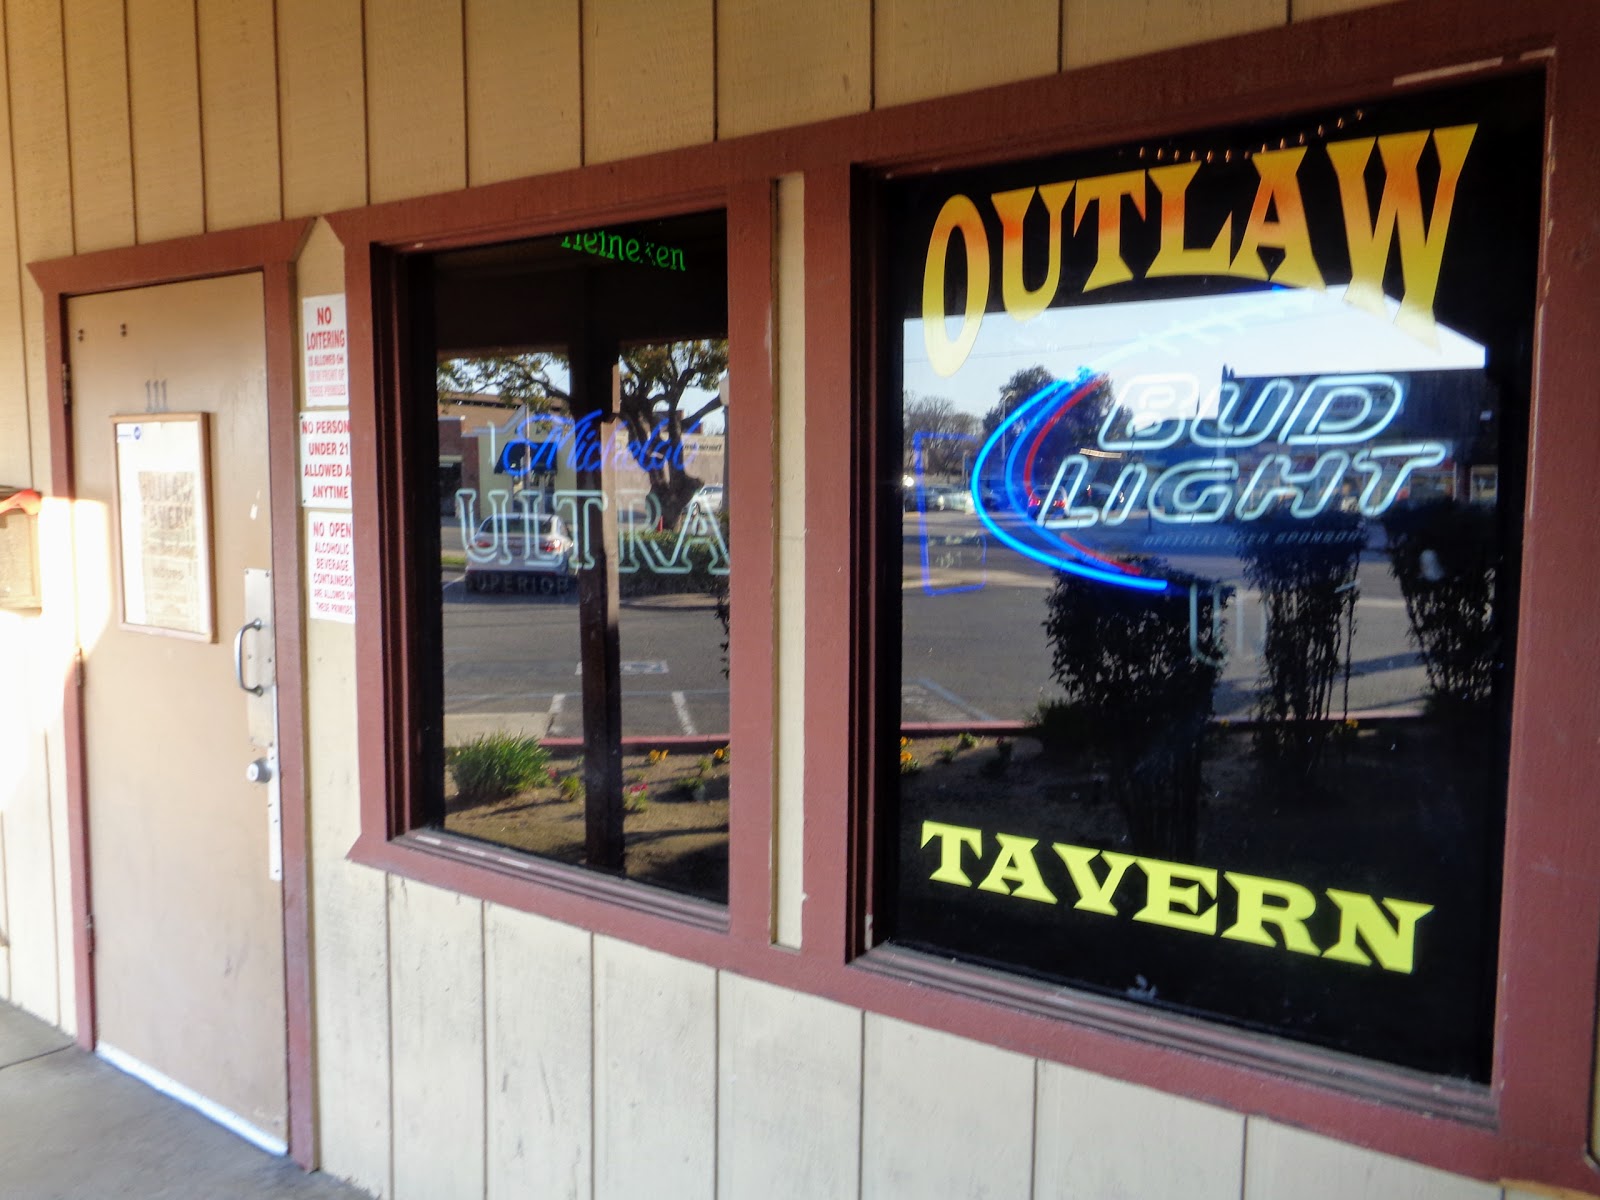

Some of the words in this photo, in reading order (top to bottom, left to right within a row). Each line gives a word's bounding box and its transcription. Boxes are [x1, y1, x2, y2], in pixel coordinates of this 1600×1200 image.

[922, 123, 1478, 378] OUTLAW
[316, 306, 332, 325] NO
[306, 330, 345, 351] LOITERING
[315, 354, 335, 366] ALLOWED
[145, 379, 168, 412] 111
[1098, 373, 1402, 449] BUD
[301, 420, 314, 434] NO
[309, 442, 337, 456] UNDER
[339, 442, 349, 456] 21
[304, 464, 343, 477] ALLOWED
[312, 486, 349, 499] ANYTIME
[1037, 442, 1446, 528] LIGHT
[313, 521, 325, 537] NO
[329, 522, 352, 538] OPEN
[455, 488, 730, 575] ULTRA
[314, 542, 350, 555] ALCOHOLIC
[316, 558, 349, 571] BEVERAGE
[313, 573, 353, 587] CONTAINERS
[921, 820, 1434, 974] TAVERN
